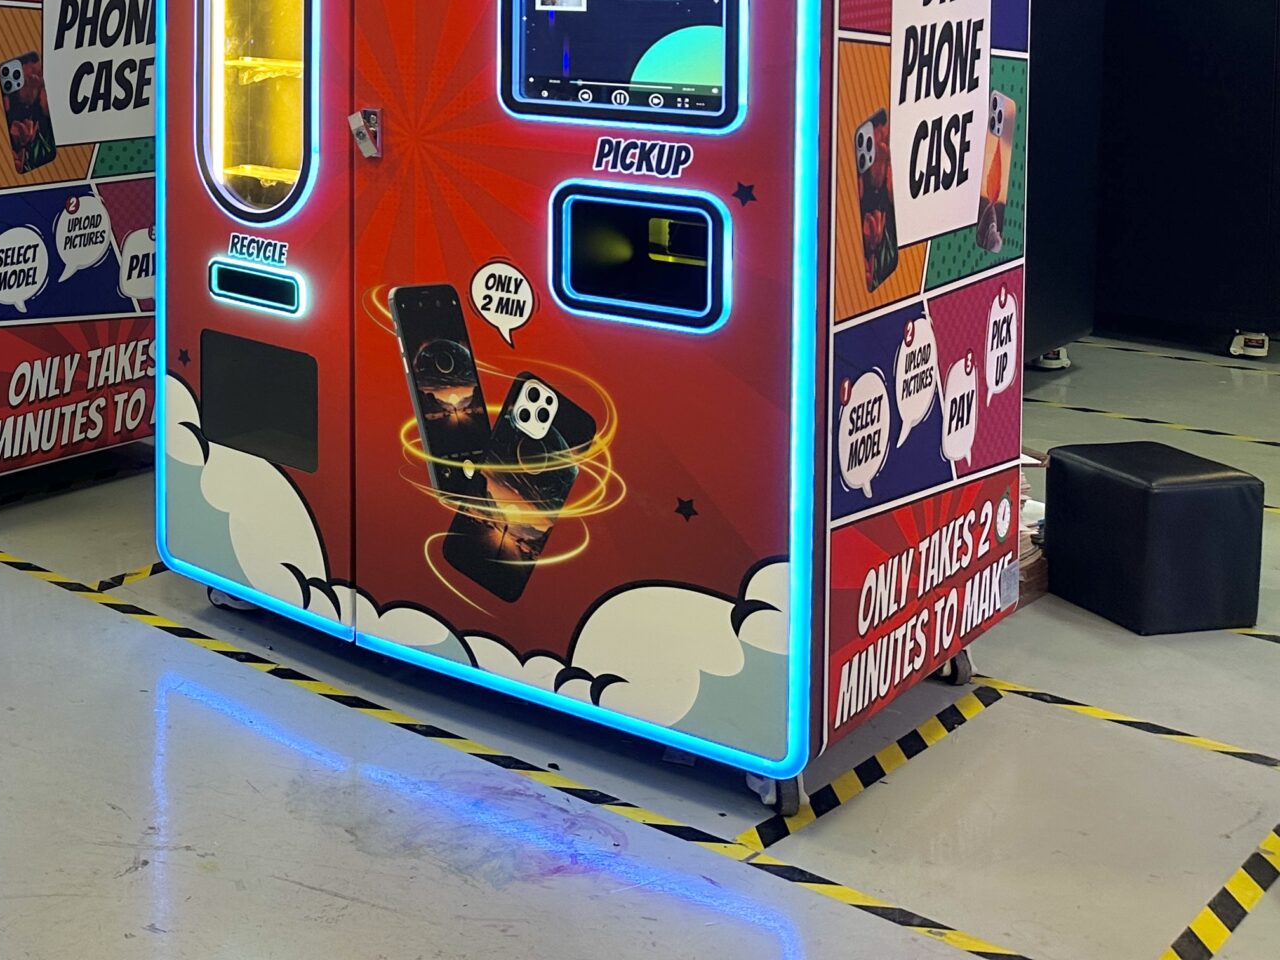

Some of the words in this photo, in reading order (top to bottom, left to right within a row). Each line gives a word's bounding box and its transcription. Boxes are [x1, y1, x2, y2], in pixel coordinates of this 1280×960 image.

[898, 18, 984, 106] PHONE
[69, 58, 155, 115] CASE
[594, 137, 692, 176] PICKUP
[908, 110, 974, 200] CASE
[69, 198, 77, 210] 2
[64, 230, 106, 251] PICTURES
[67, 214, 101, 232] UPLOAD
[229, 234, 287, 264] RECYCLE
[484, 272, 524, 296] ONLY
[481, 294, 494, 313] 2
[494, 296, 526, 318] MIN
[905, 323, 913, 343] 2
[990, 311, 1013, 352] PICK
[904, 343, 931, 377] UPLOAD
[965, 353, 973, 371] 3
[995, 350, 1008, 386] UP
[8, 354, 79, 406] ONLY
[843, 381, 850, 400] 1
[901, 368, 934, 402] PICTURES
[113, 388, 146, 433] TO
[848, 394, 884, 437] SELECT
[946, 389, 976, 437] PAY
[846, 431, 882, 473] MODEL
[858, 552, 914, 637] ONLY
[917, 513, 975, 601] TAKES
[977, 500, 993, 557] 2
[833, 614, 930, 730] MINUTES
[932, 586, 959, 662] TO
[960, 551, 1014, 640] MAK
